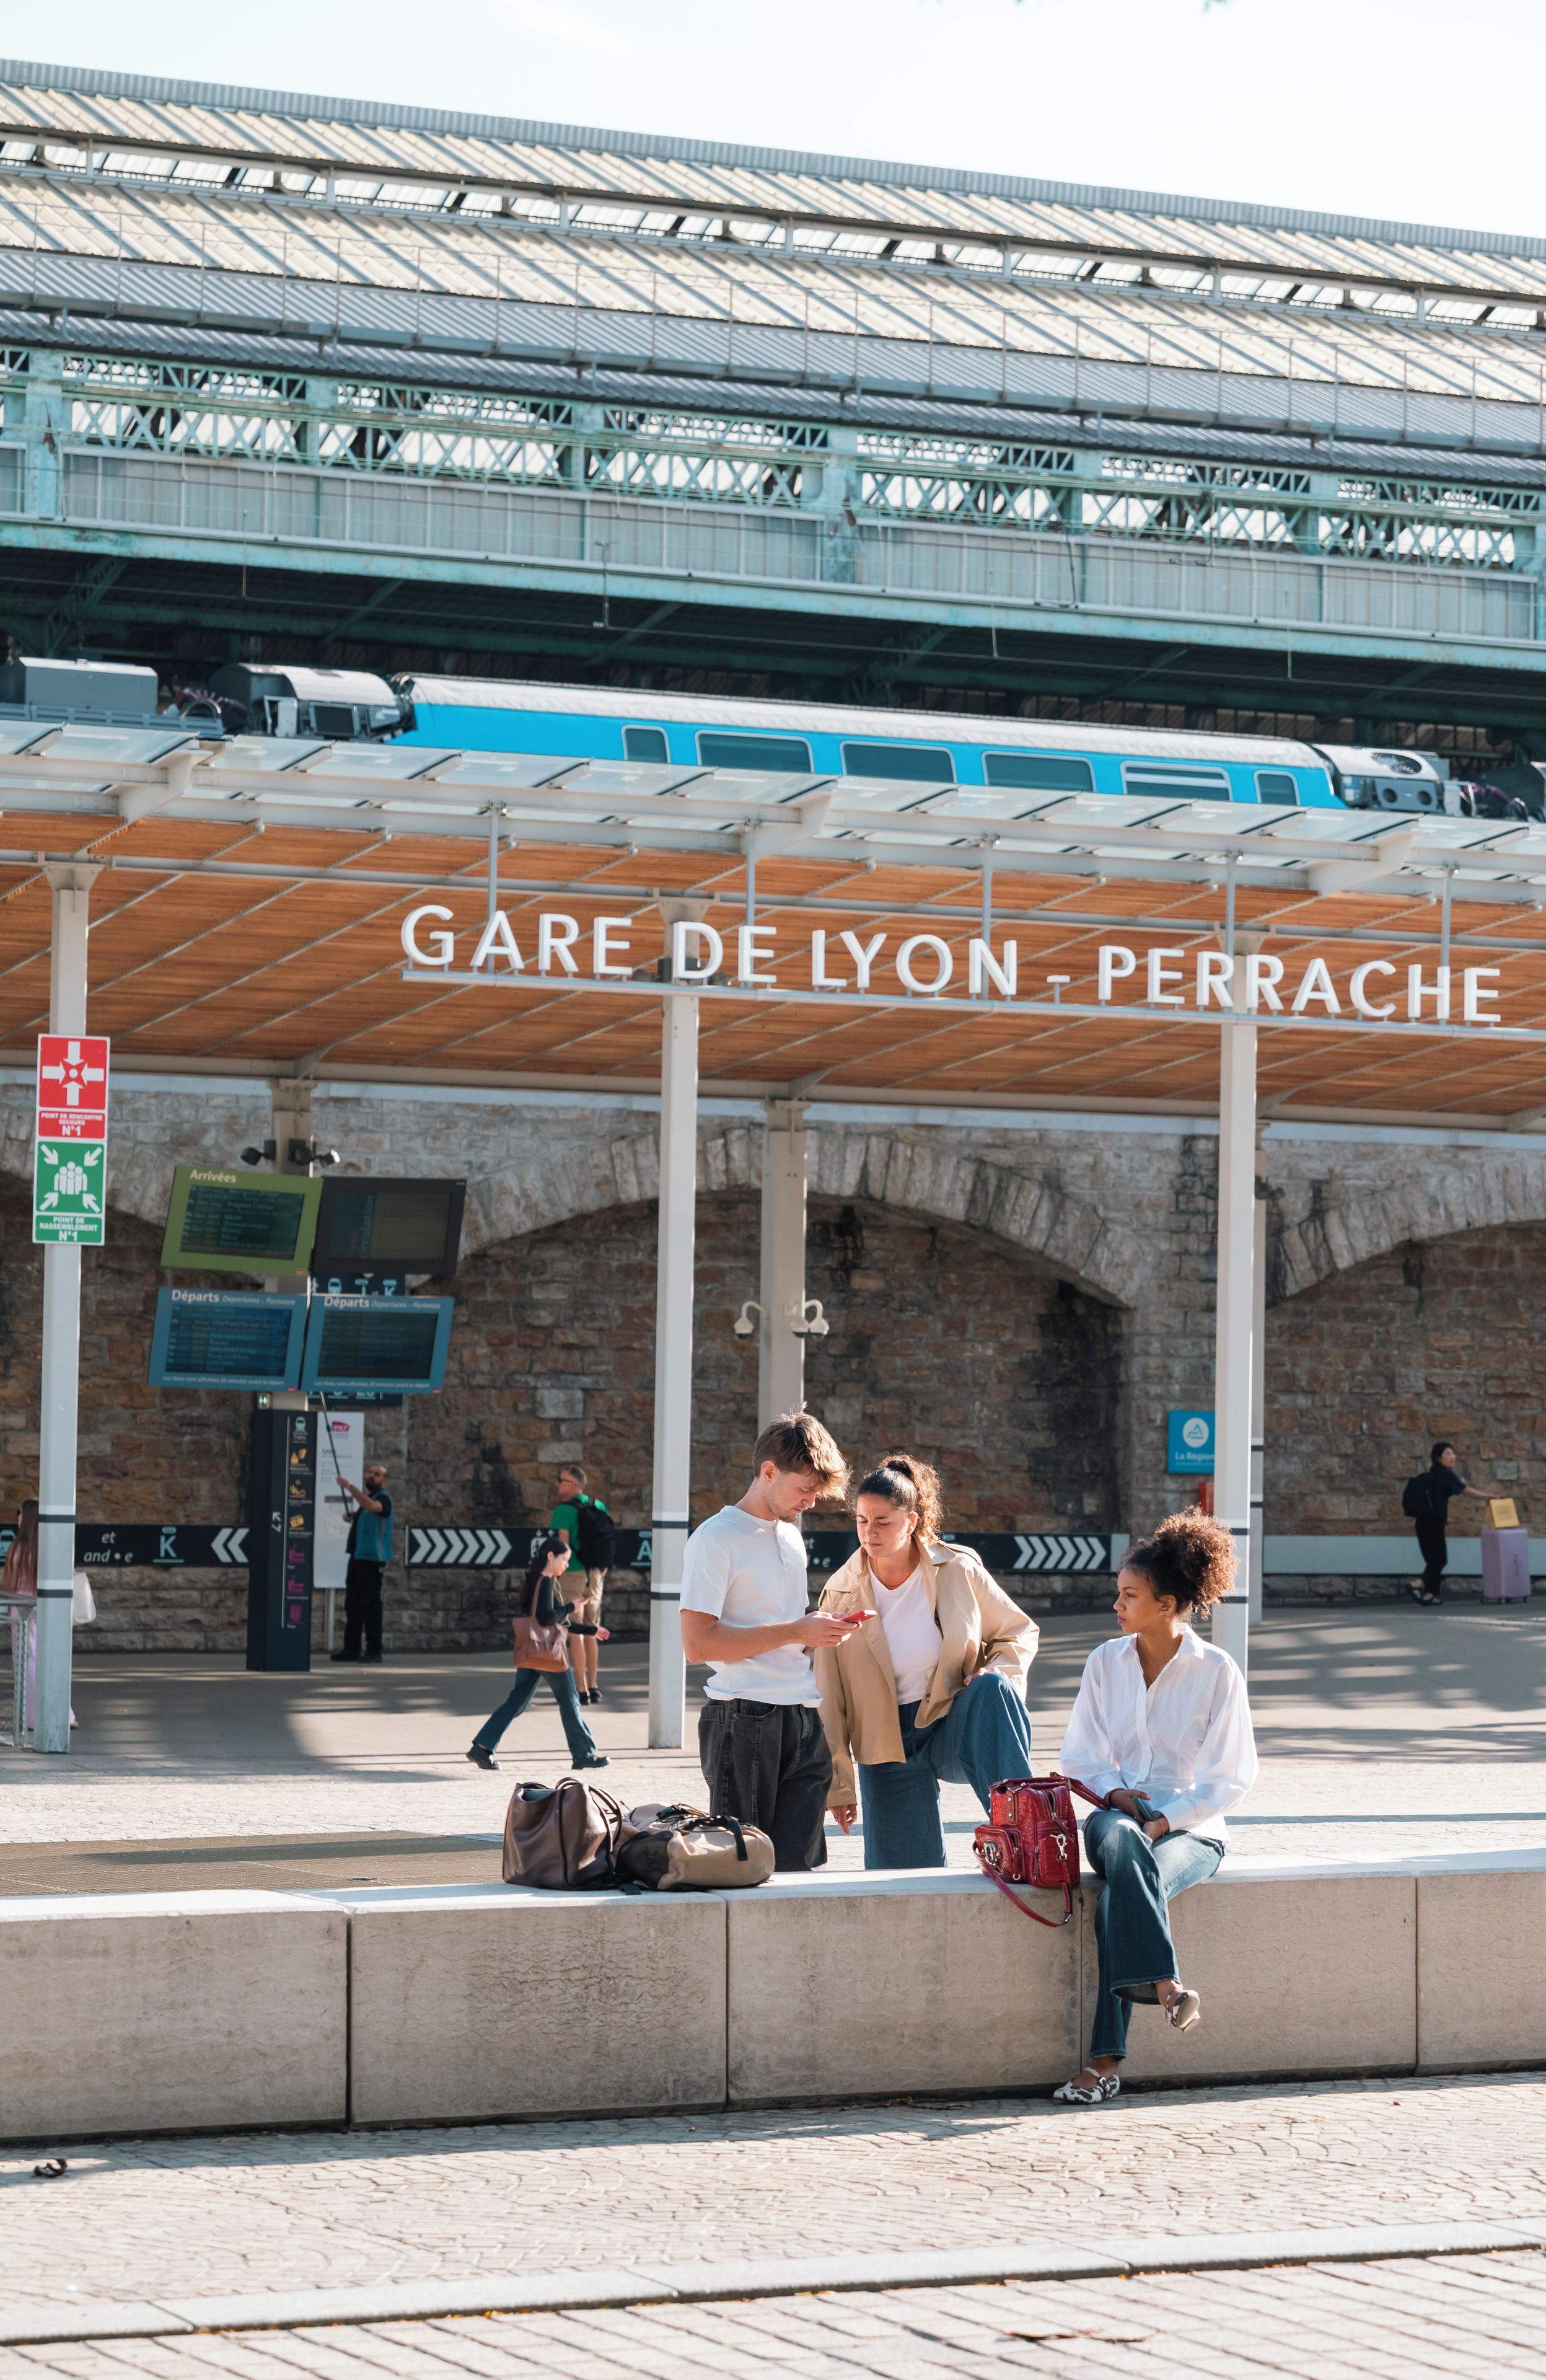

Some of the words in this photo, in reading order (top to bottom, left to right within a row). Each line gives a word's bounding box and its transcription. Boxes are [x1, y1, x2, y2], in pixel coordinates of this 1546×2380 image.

[401, 904, 633, 976] GARE
[673, 921, 777, 984] DE
[811, 929, 1017, 995] LYON
[1098, 945, 1501, 1023] PERRACHE
[68, 1113, 103, 1121] RENCONTRE
[189, 1169, 237, 1183] Arrivées
[39, 1222, 98, 1232] RASSEMBLEMENT
[172, 1289, 219, 1304] Départs
[222, 1295, 260, 1304] Departures
[324, 1297, 370, 1310] Départs
[1175, 1452, 1185, 1460] La
[101, 1531, 116, 1544] et
[159, 1535, 177, 1558] K
[636, 1540, 652, 1561] A
[84, 1548, 111, 1562] and
